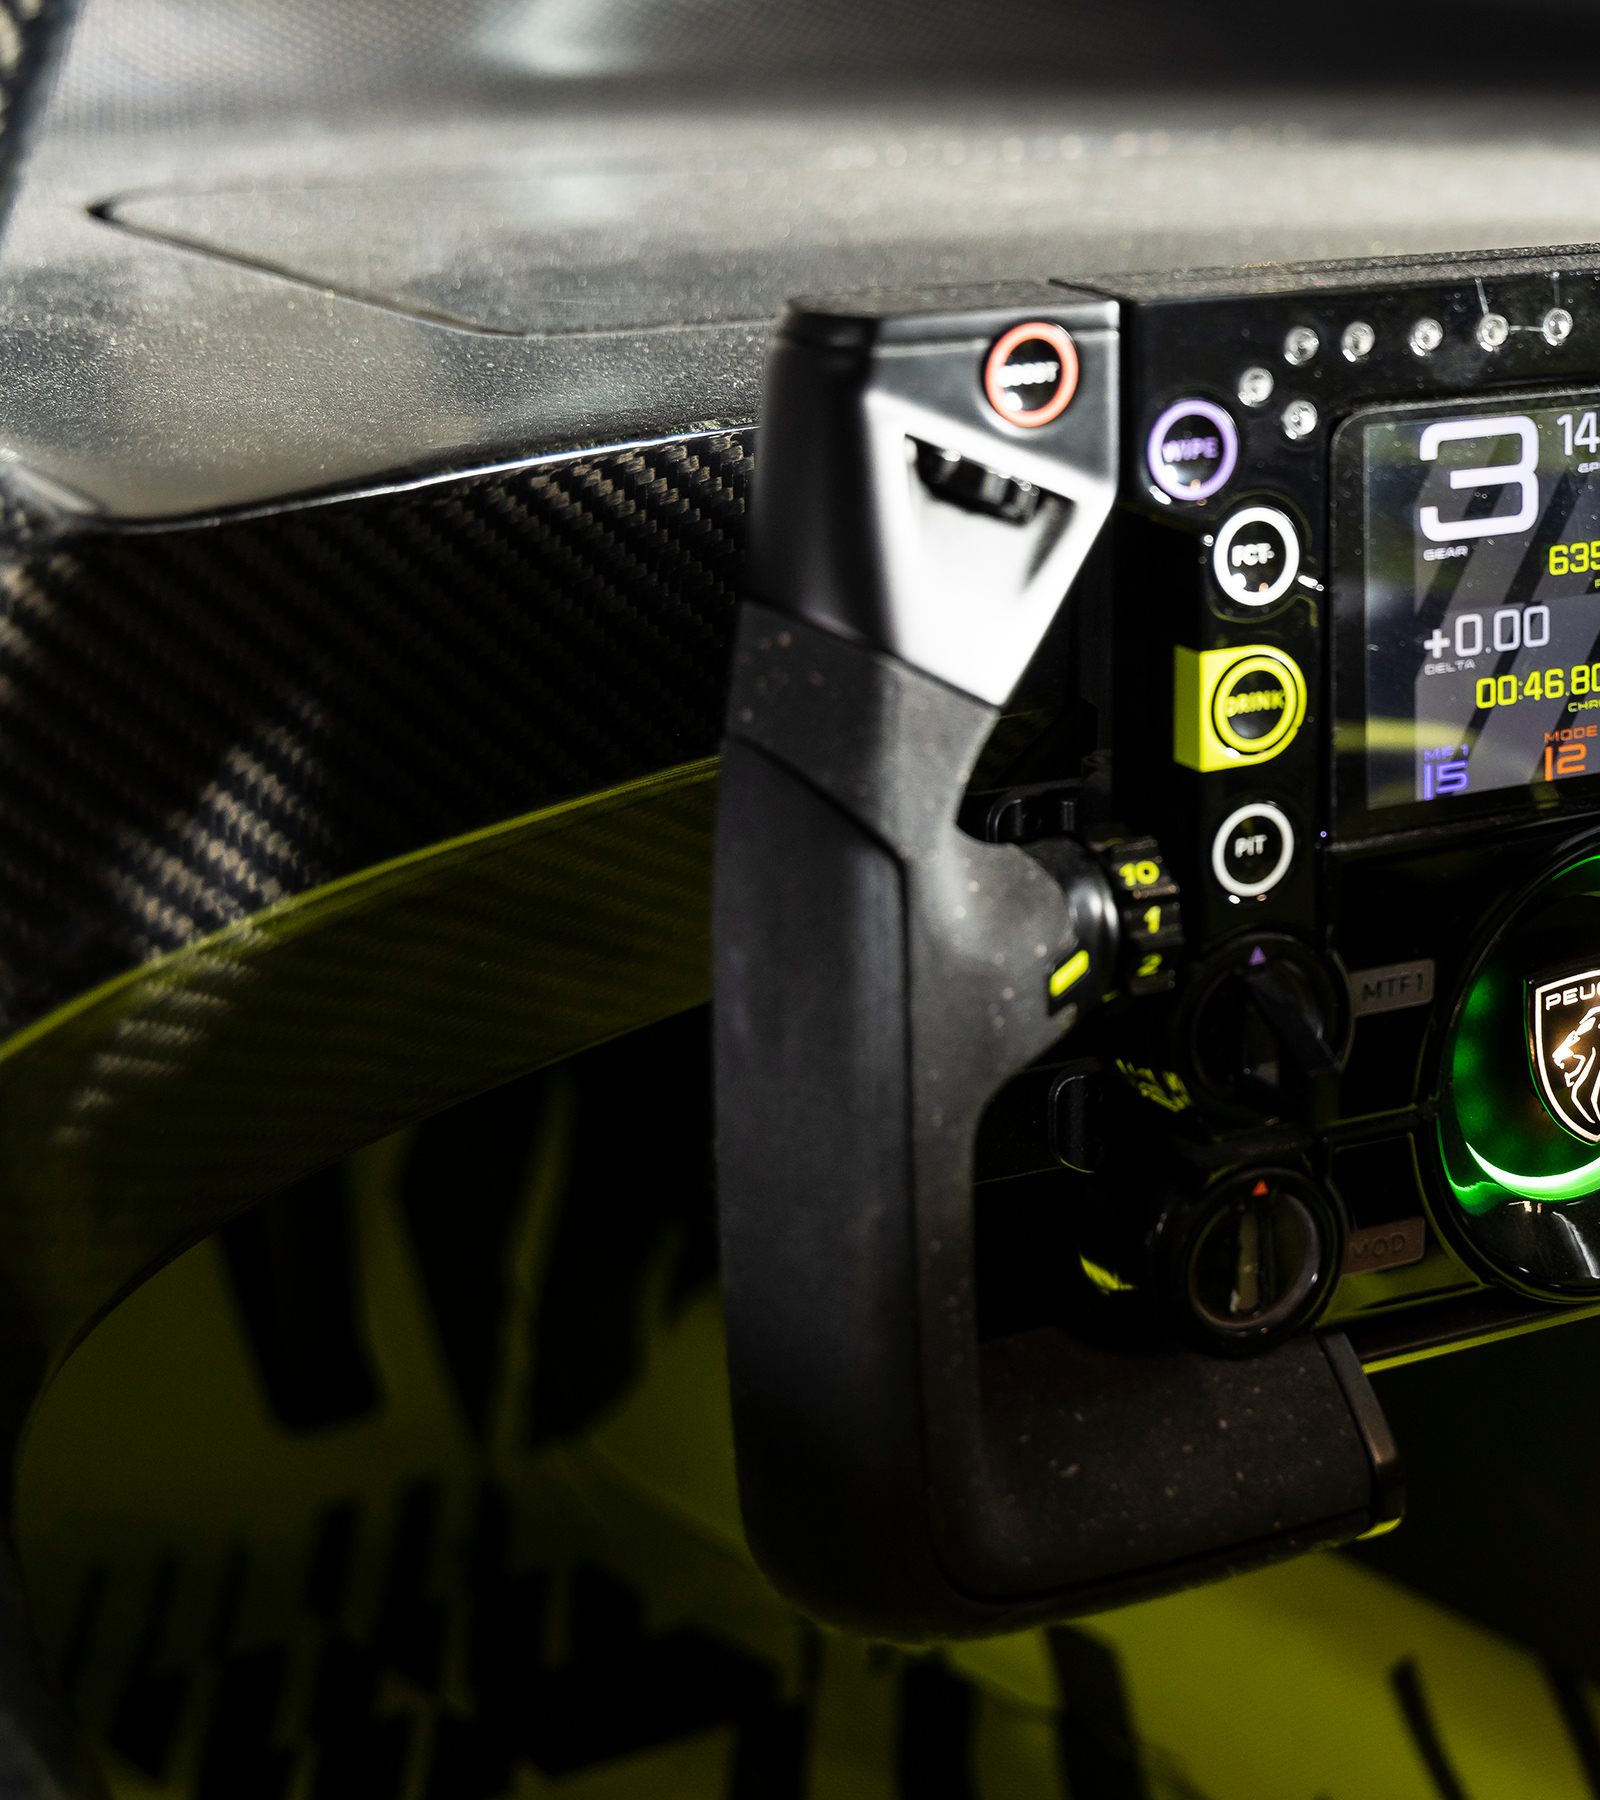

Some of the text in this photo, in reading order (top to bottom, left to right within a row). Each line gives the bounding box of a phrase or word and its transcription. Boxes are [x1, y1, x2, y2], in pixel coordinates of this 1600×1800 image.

[1162, 436, 1219, 463] WIPE
[1419, 415, 1539, 542] 3
[1423, 546, 1469, 562] GEAR
[1423, 606, 1550, 659] +0.00
[1424, 658, 1476, 676] DELTA
[1544, 725, 1598, 743] MODE
[1424, 744, 1469, 761] MF 1
[1545, 744, 1588, 782] 12
[1423, 760, 1470, 801] 15
[1234, 835, 1268, 858] PIT
[1118, 860, 1160, 887] 10
[1143, 905, 1162, 935] 1
[1136, 953, 1163, 978] 2
[1361, 972, 1424, 1003] MTF1
